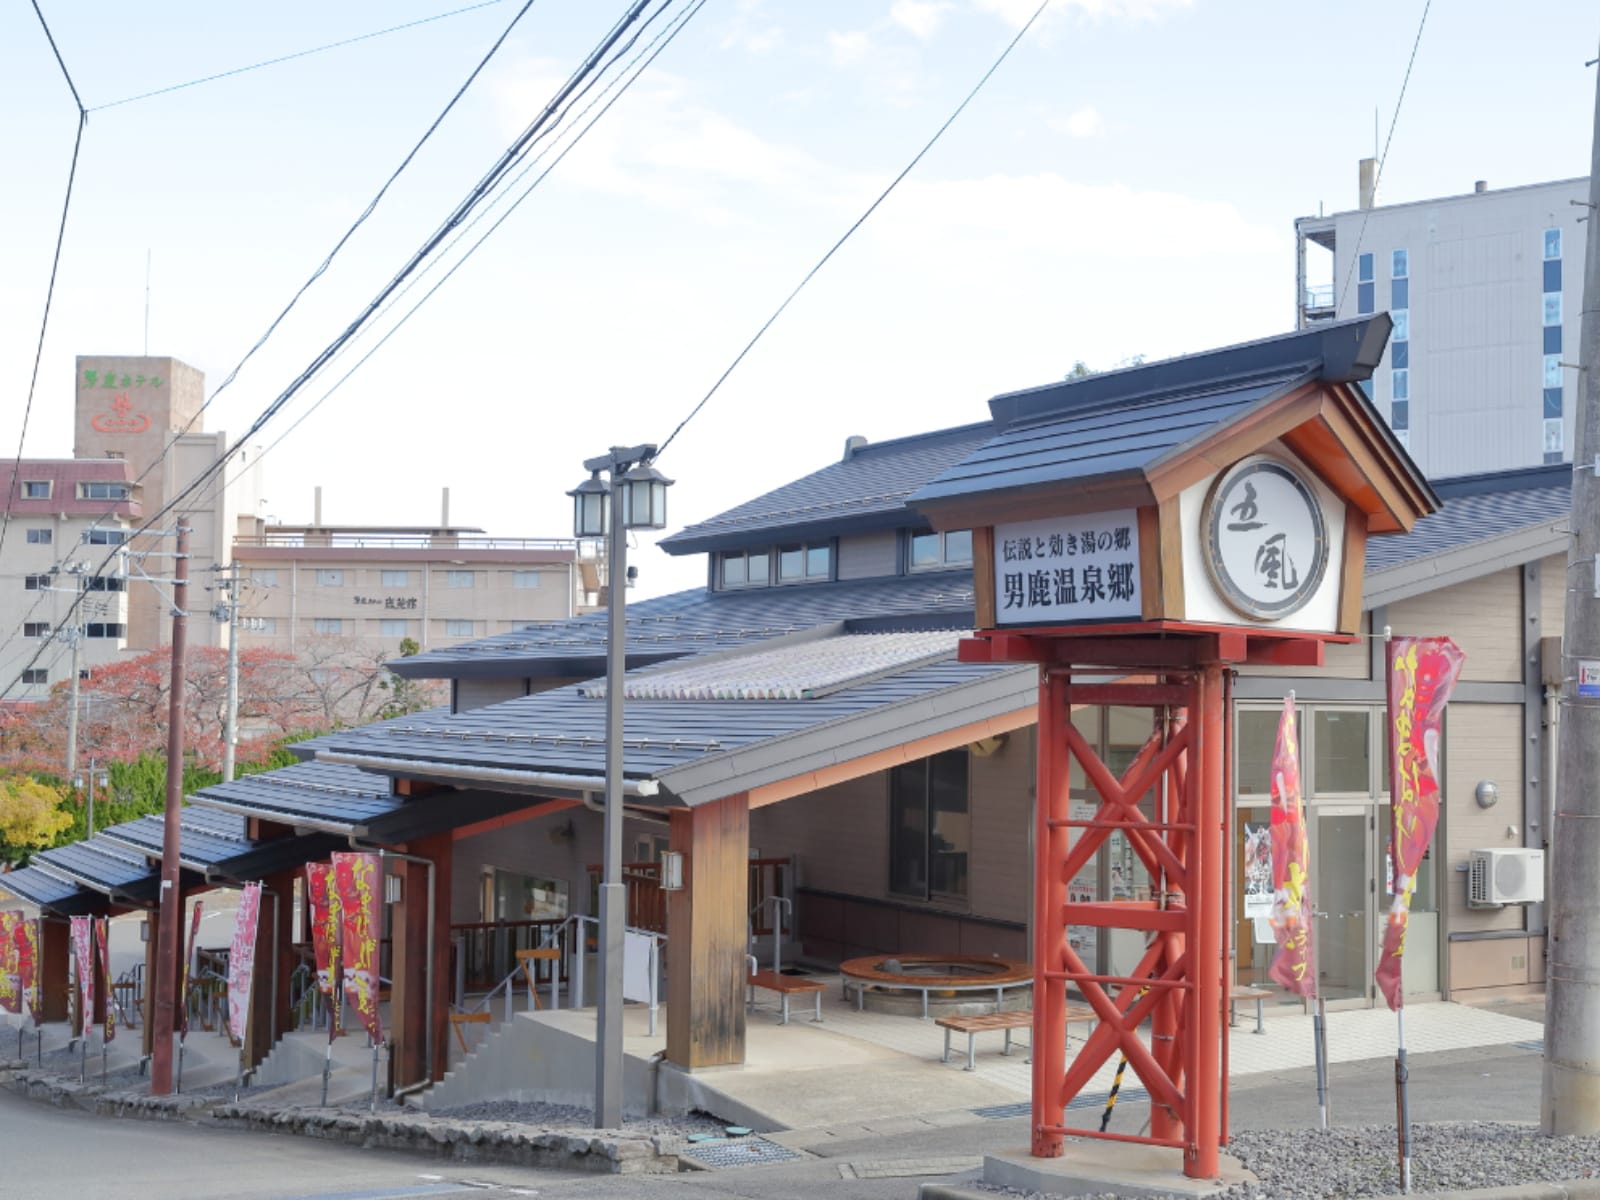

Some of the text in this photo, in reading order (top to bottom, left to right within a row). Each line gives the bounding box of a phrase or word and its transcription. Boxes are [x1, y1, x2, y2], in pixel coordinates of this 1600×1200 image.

[1003, 526, 1130, 562] 伝説と効き湯の郷
[1003, 562, 1134, 609] 男鹿温泉郷
